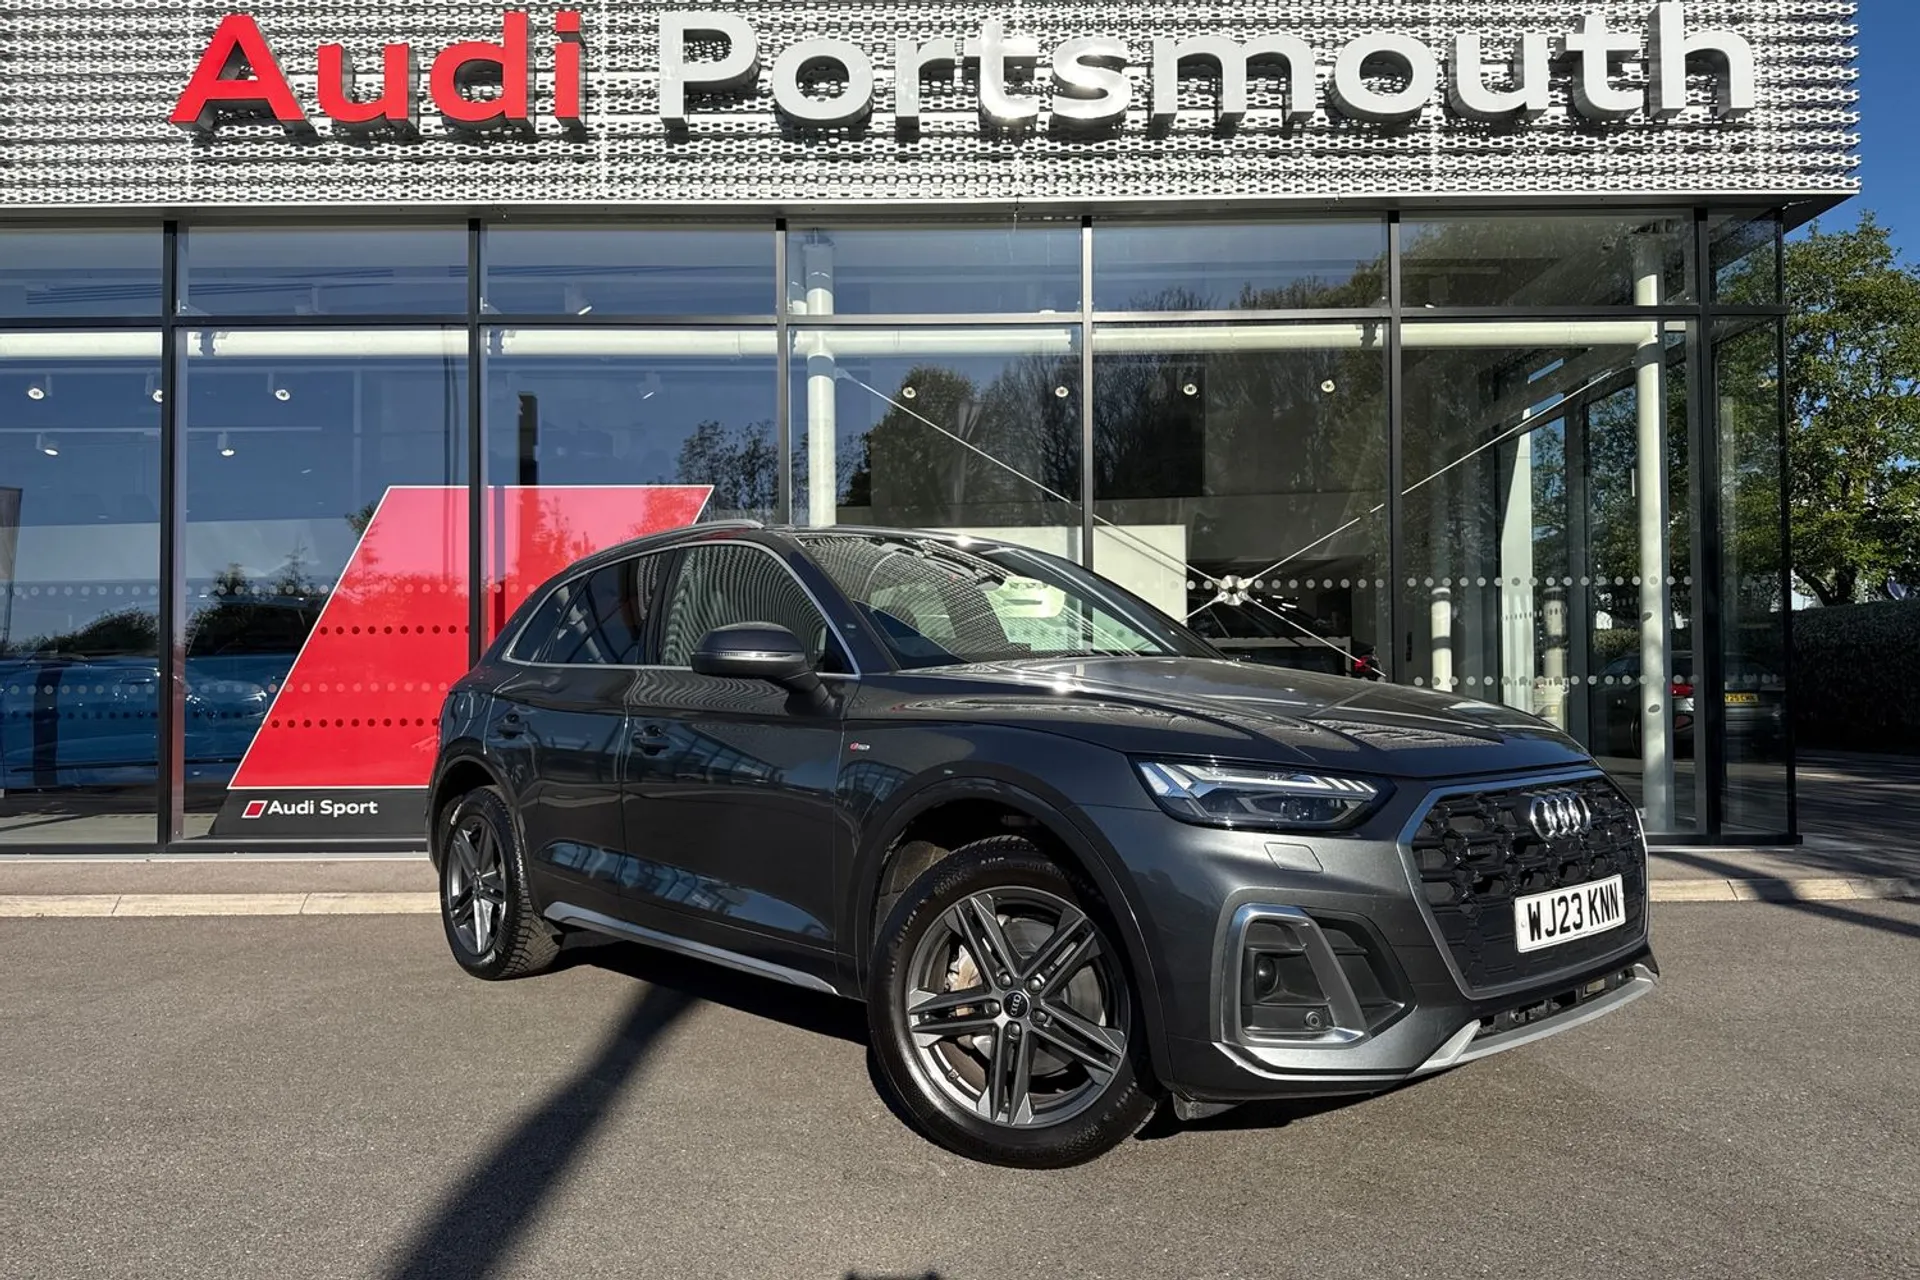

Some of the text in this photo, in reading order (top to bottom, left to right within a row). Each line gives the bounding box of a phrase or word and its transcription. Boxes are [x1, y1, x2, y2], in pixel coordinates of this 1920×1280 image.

[170, 0, 1754, 125] Audi Portsmouth
[267, 799, 379, 818] Audi Sport
[1527, 882, 1620, 942] WJ23 KNN
